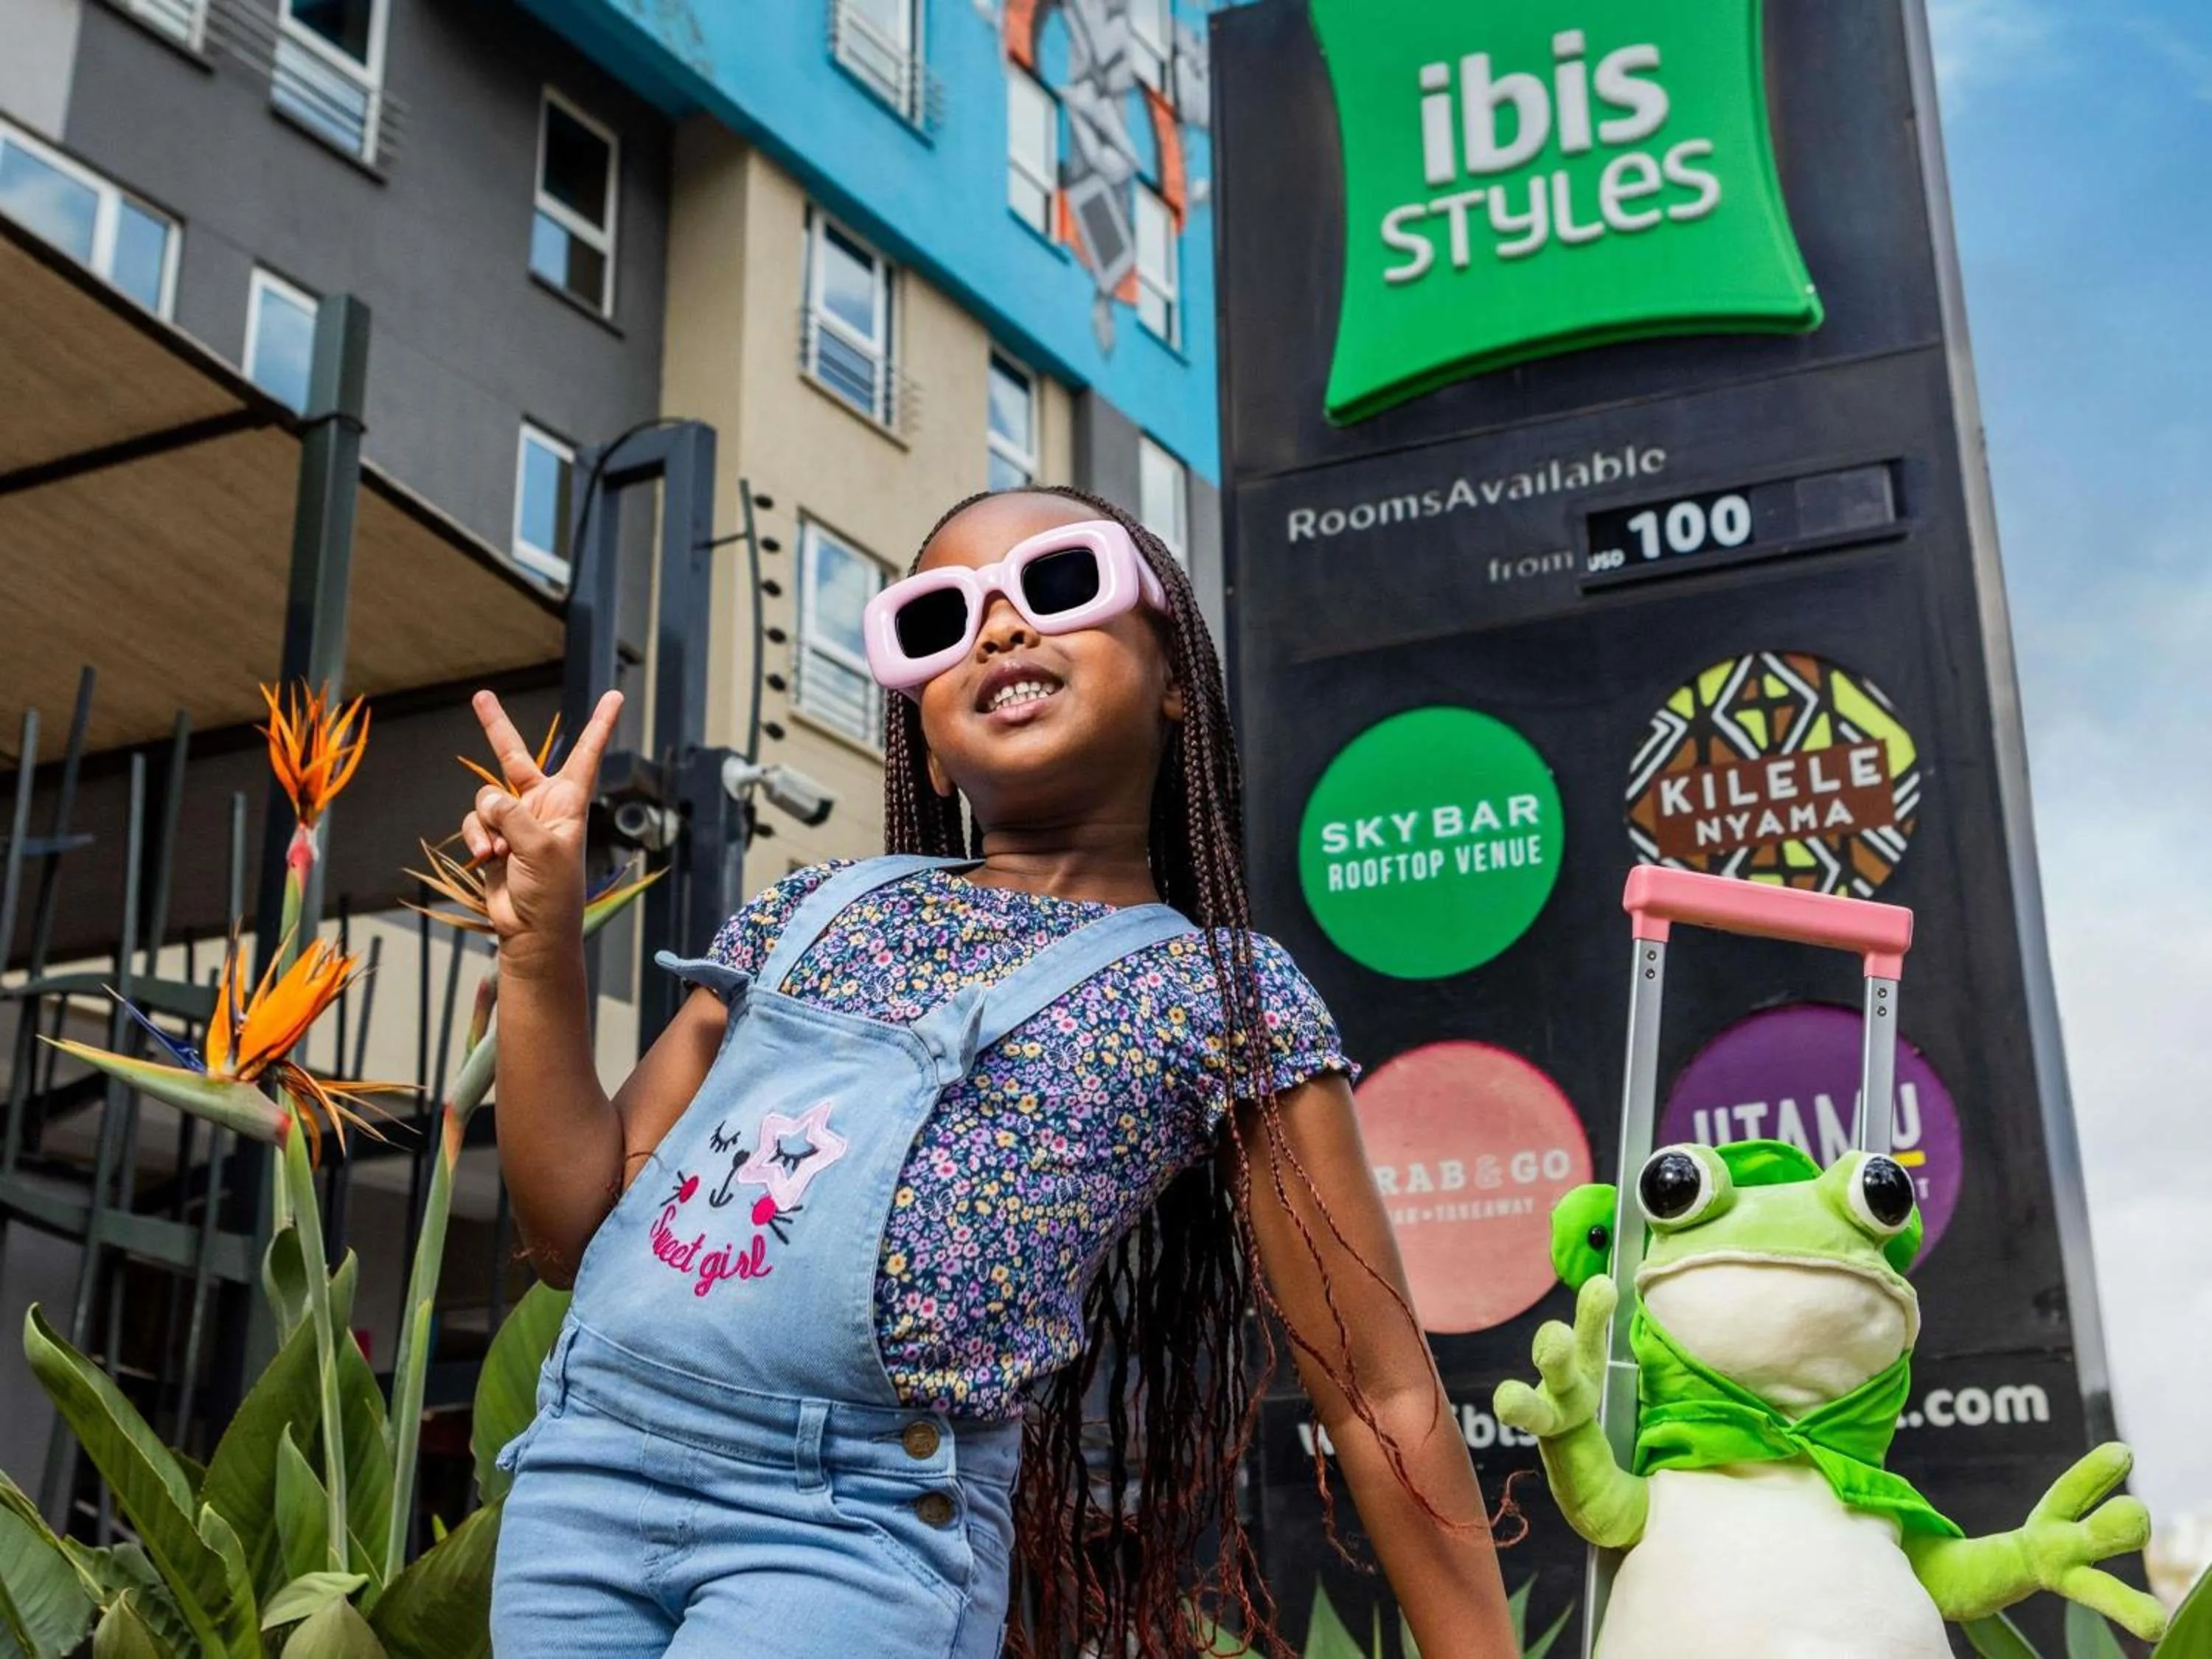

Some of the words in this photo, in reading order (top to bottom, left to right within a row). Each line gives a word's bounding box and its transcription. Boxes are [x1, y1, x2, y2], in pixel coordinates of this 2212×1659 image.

[1419, 29, 1669, 187] ibis
[1627, 494, 1751, 559] 100
[1488, 551, 1574, 582] from
[1587, 548, 1626, 572] USD
[1660, 745, 1882, 816] KILELE
[1321, 810, 1419, 854] SKY
[1432, 793, 1540, 838] BAR
[1696, 798, 1854, 846] NYAMA
[1329, 849, 1445, 893] ROOFTOP
[1454, 835, 1543, 874] VENUE
[1373, 1159, 1467, 1197] RAB
[650, 1204, 706, 1273] Sweet
[694, 1234, 773, 1298] girl
